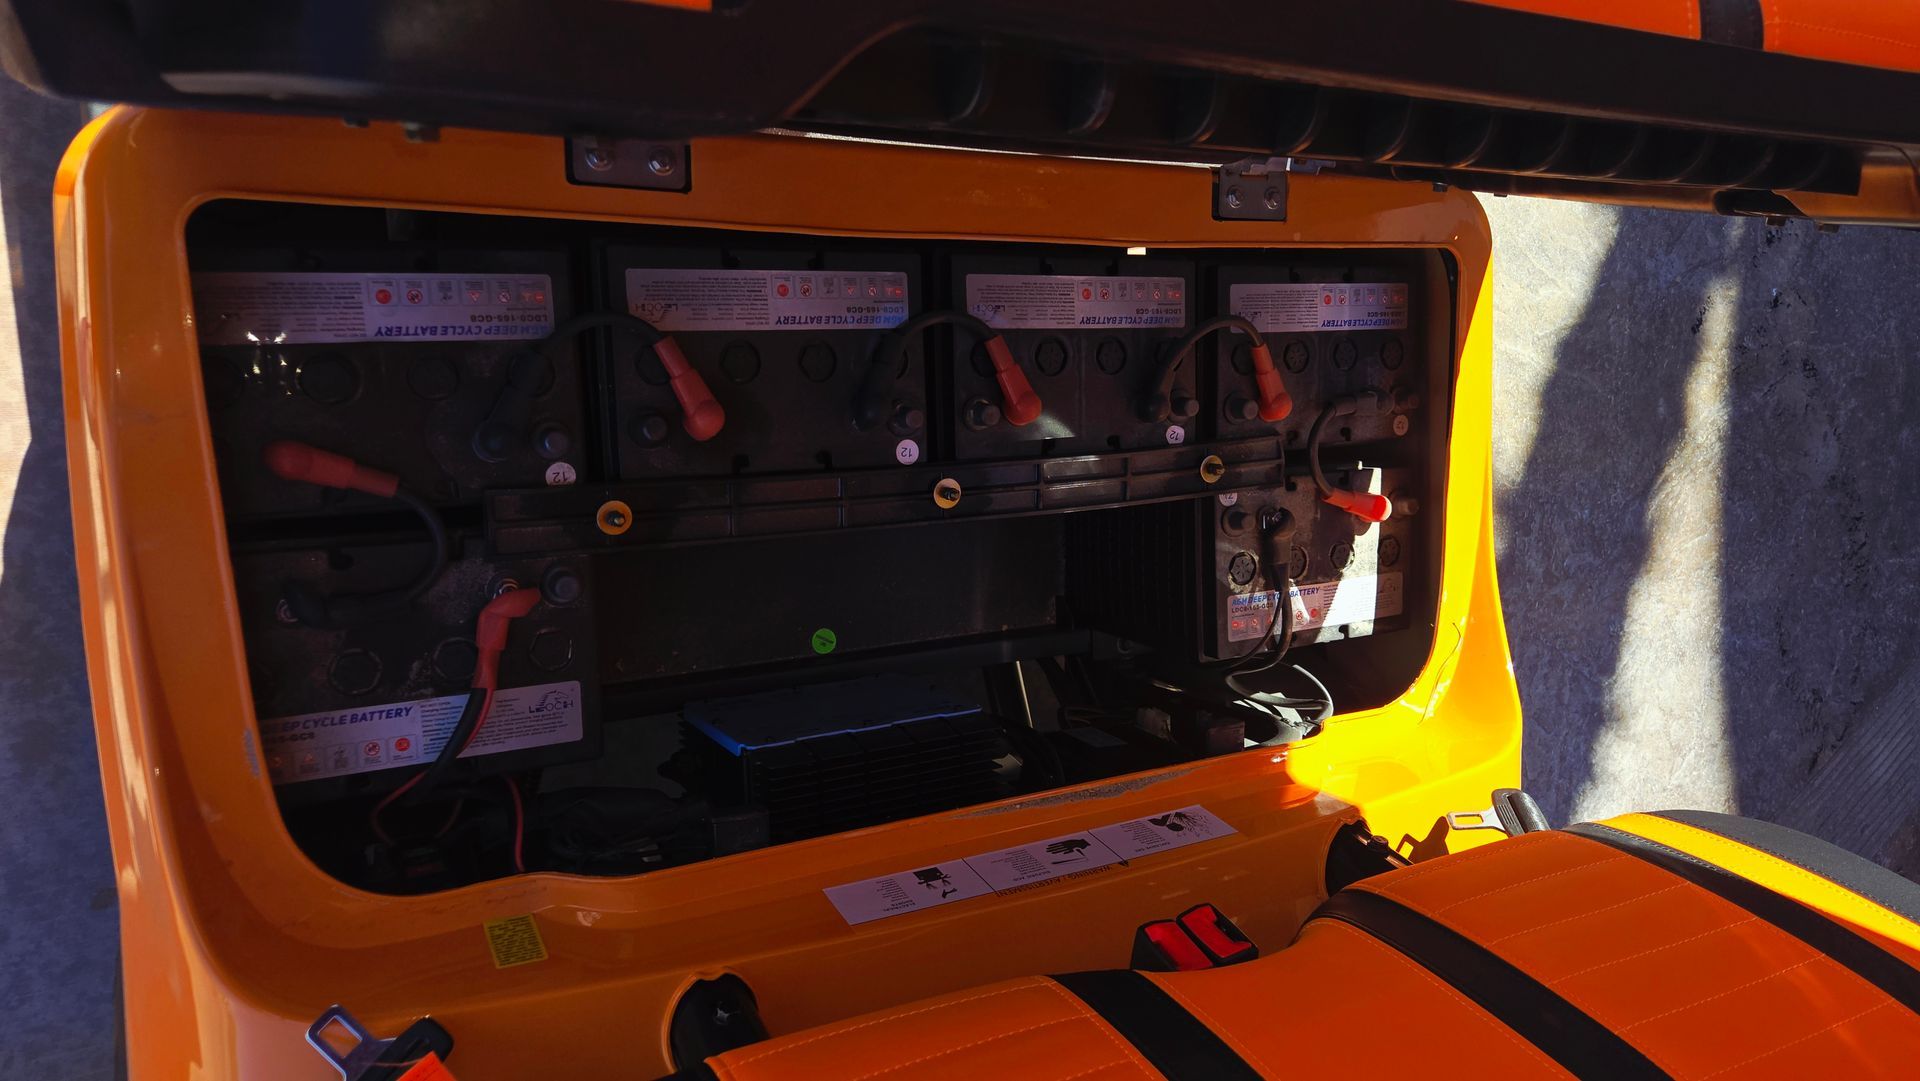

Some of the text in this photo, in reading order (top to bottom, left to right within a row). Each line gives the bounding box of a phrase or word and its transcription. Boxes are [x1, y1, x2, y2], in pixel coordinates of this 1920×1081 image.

[776, 315, 823, 325] BATTERY
[825, 315, 855, 325] CYCLE
[856, 315, 881, 325] DEEP
[1080, 316, 1117, 325] BATTERY
[1118, 316, 1142, 325] CYCLE
[1143, 316, 1163, 325] DEEP
[1353, 319, 1373, 327] CYCLE
[374, 326, 438, 337] BATTERY
[441, 326, 482, 336] CYCLE
[484, 325, 518, 336] DEEP
[901, 447, 912, 458] 12
[552, 472, 568, 483] 12
[1248, 595, 1266, 604] DEEP
[1290, 587, 1320, 598] BATTERY
[302, 714, 347, 730] CYCLE
[350, 706, 413, 724] BATTERY
